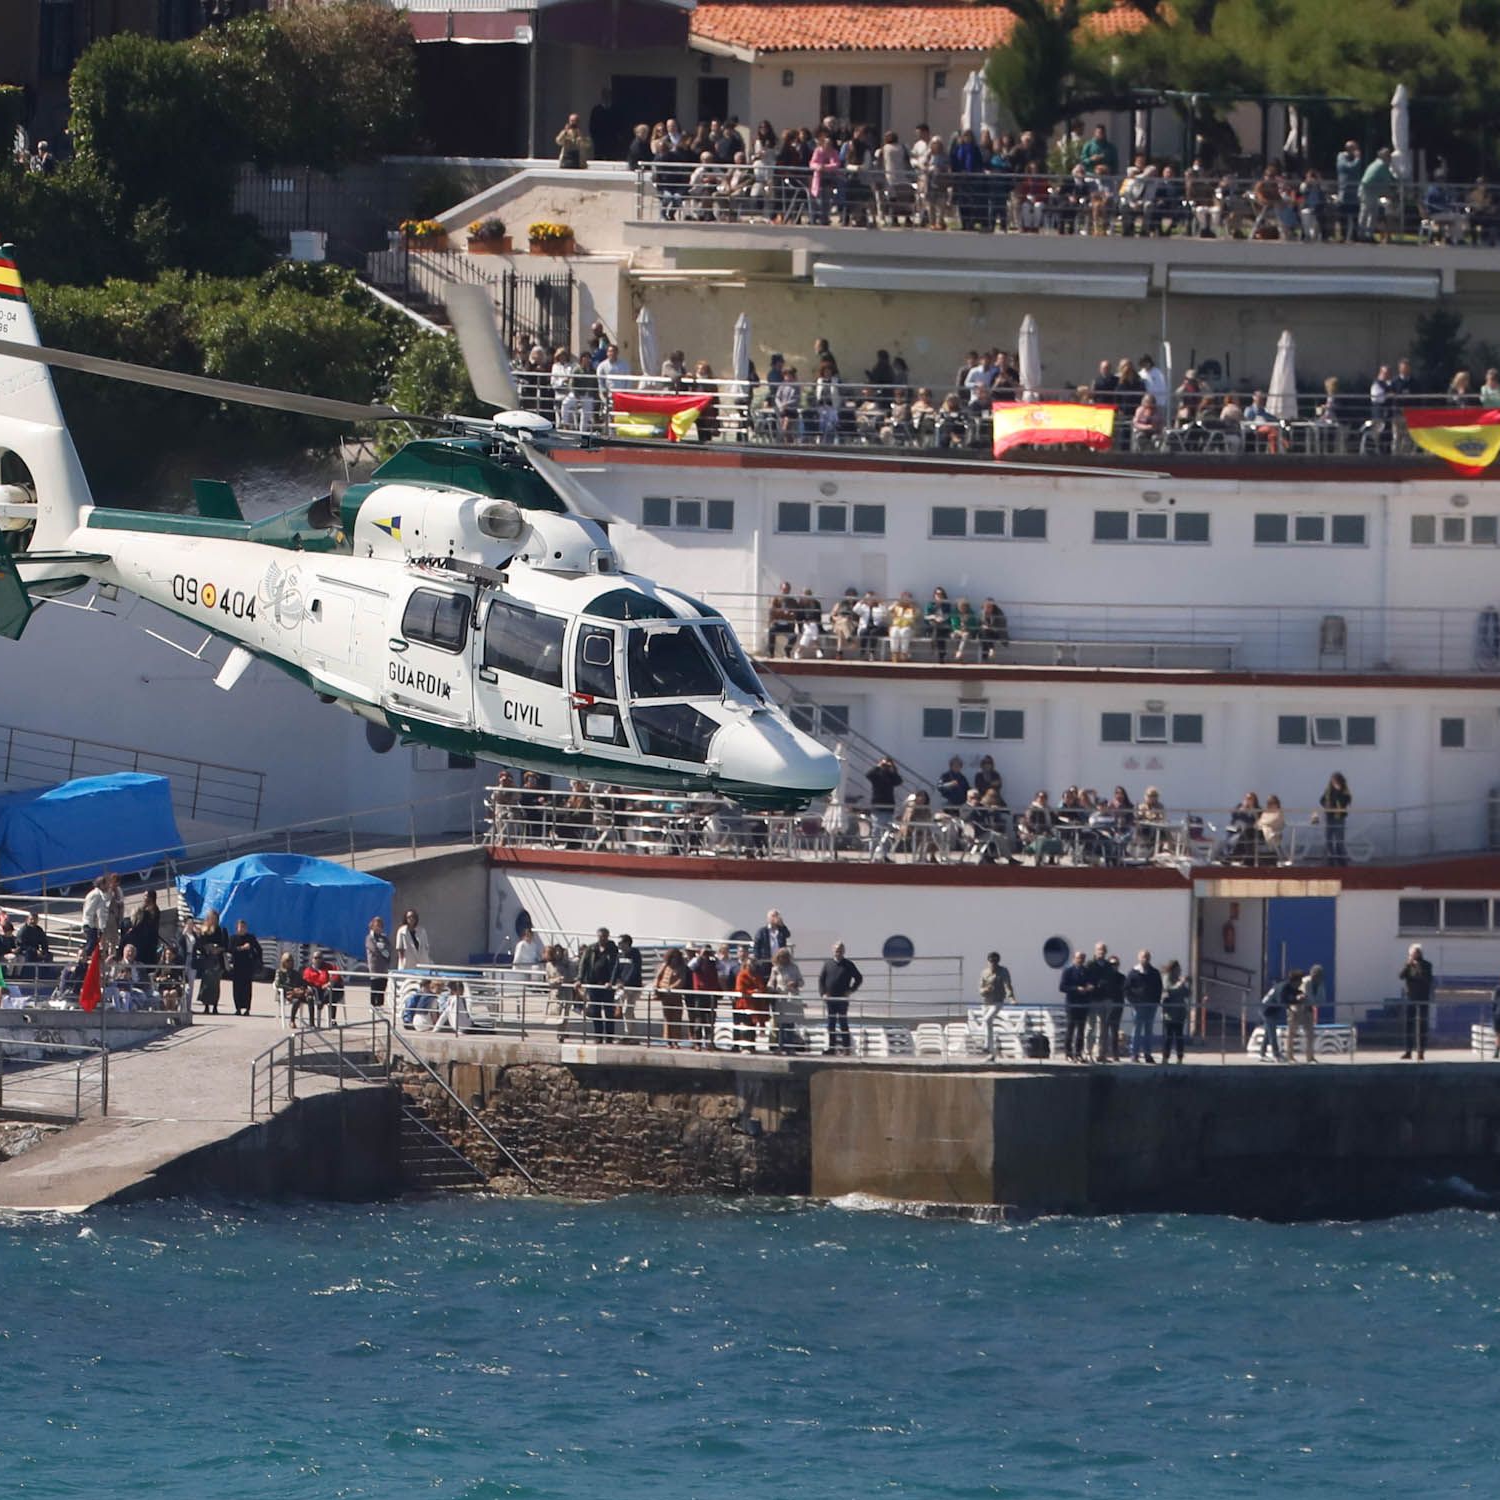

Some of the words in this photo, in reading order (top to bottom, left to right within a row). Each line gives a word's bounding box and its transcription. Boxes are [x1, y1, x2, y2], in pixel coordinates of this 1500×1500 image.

[173, 574, 198, 605] 09
[220, 588, 256, 622] 404
[389, 662, 451, 700] GUARDIA
[504, 700, 543, 728] CIVIL
